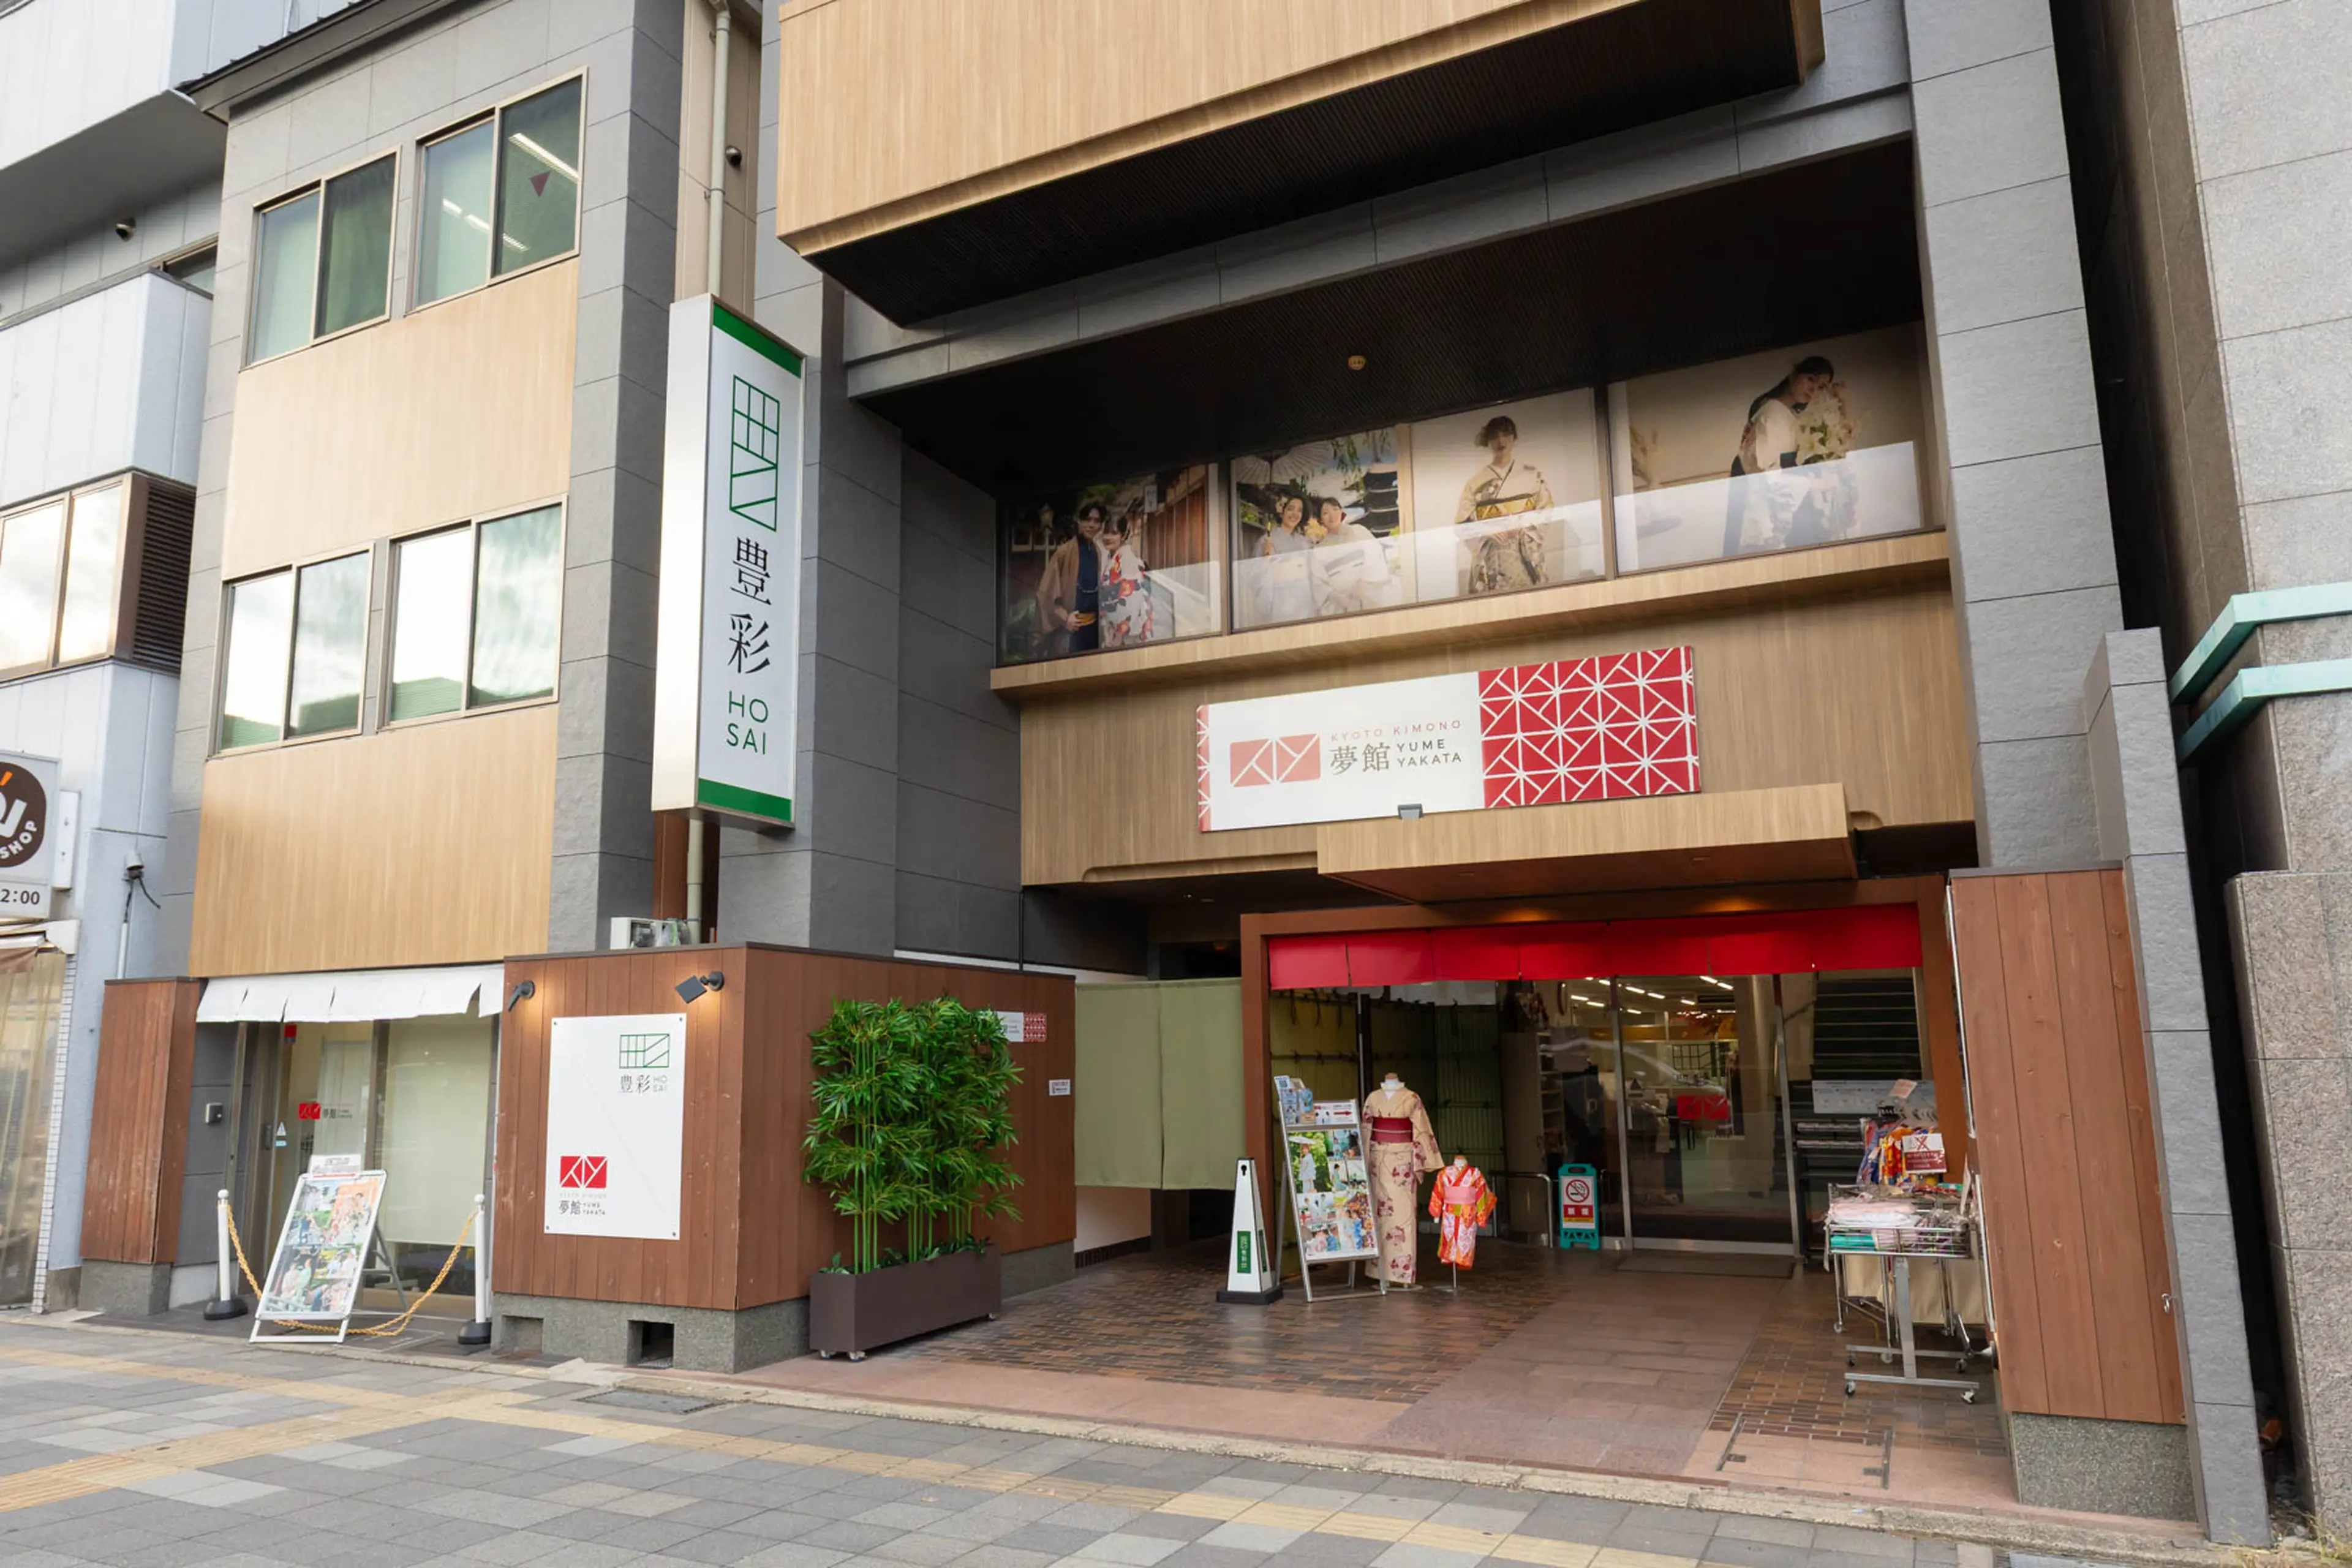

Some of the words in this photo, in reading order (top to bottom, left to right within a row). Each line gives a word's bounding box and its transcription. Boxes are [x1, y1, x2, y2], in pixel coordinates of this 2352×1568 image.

[727, 537, 772, 674] 豊彩
[729, 690, 769, 723] HO
[726, 723, 766, 755] SAI
[1330, 728, 1383, 742] KYOTO
[1393, 720, 1461, 736] KIMONO
[1396, 739, 1445, 753] YUME
[1329, 742, 1390, 775] 夢館
[1396, 752, 1462, 767] YAKATA
